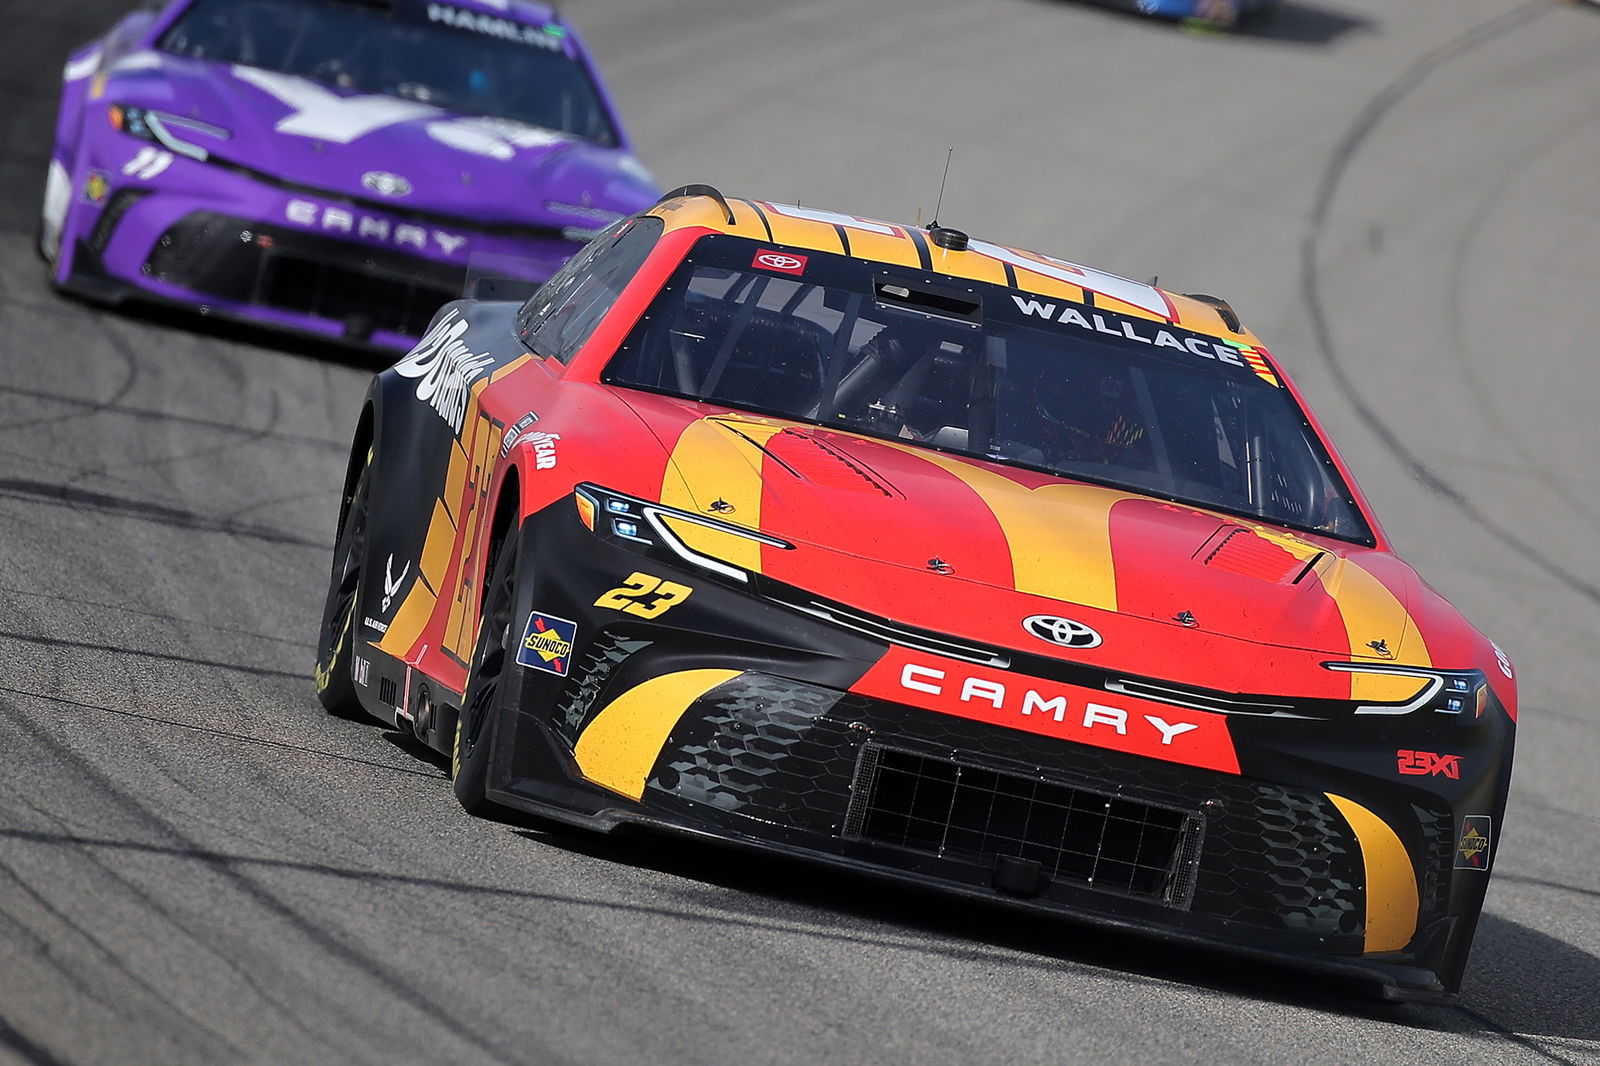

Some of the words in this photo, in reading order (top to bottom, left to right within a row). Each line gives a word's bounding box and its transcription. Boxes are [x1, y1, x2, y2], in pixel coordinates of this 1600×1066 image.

[427, 4, 561, 51] HAMLIN
[286, 199, 468, 254] CAMRY
[1011, 295, 1244, 367] WALLACE
[593, 571, 694, 620] 23
[528, 635, 569, 655] SUNOCO
[900, 662, 1199, 745] CAMRY
